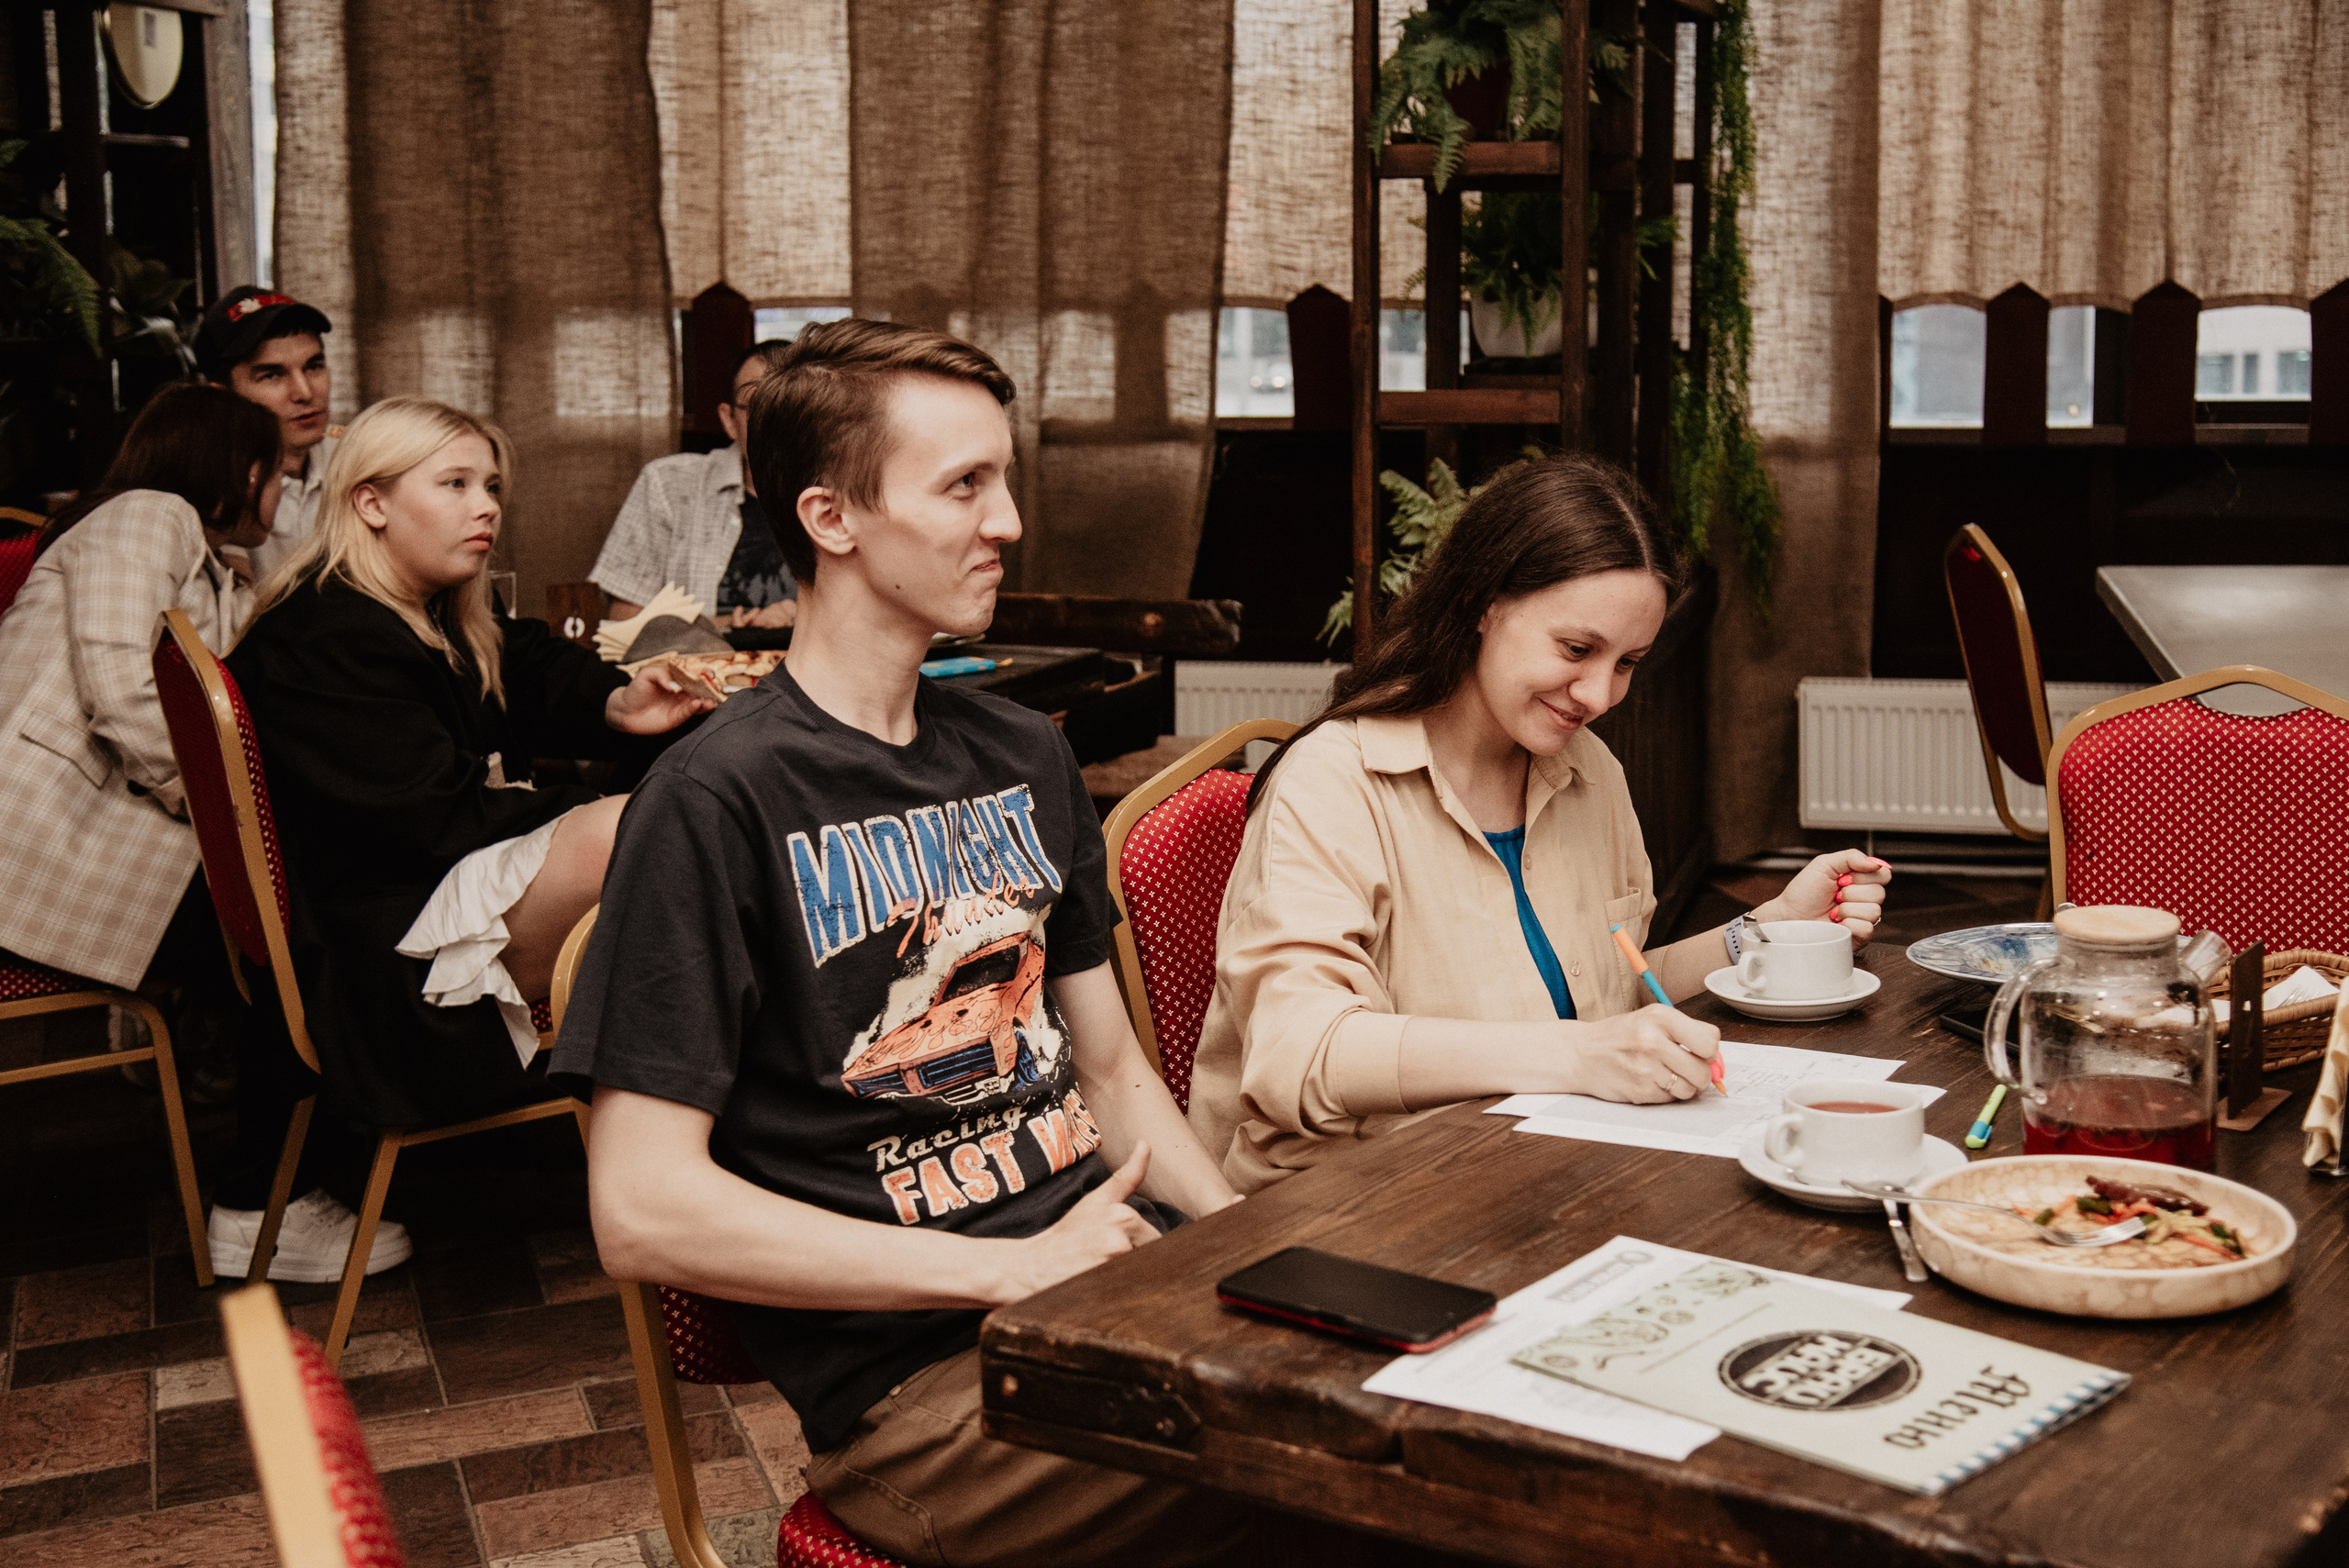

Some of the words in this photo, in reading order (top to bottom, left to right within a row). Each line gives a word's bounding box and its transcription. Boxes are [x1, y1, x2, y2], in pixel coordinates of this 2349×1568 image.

[786, 784, 1063, 968] MIDNIGHT
[867, 1106, 1028, 1173] Racing
[882, 1129, 1026, 1225] FAST
